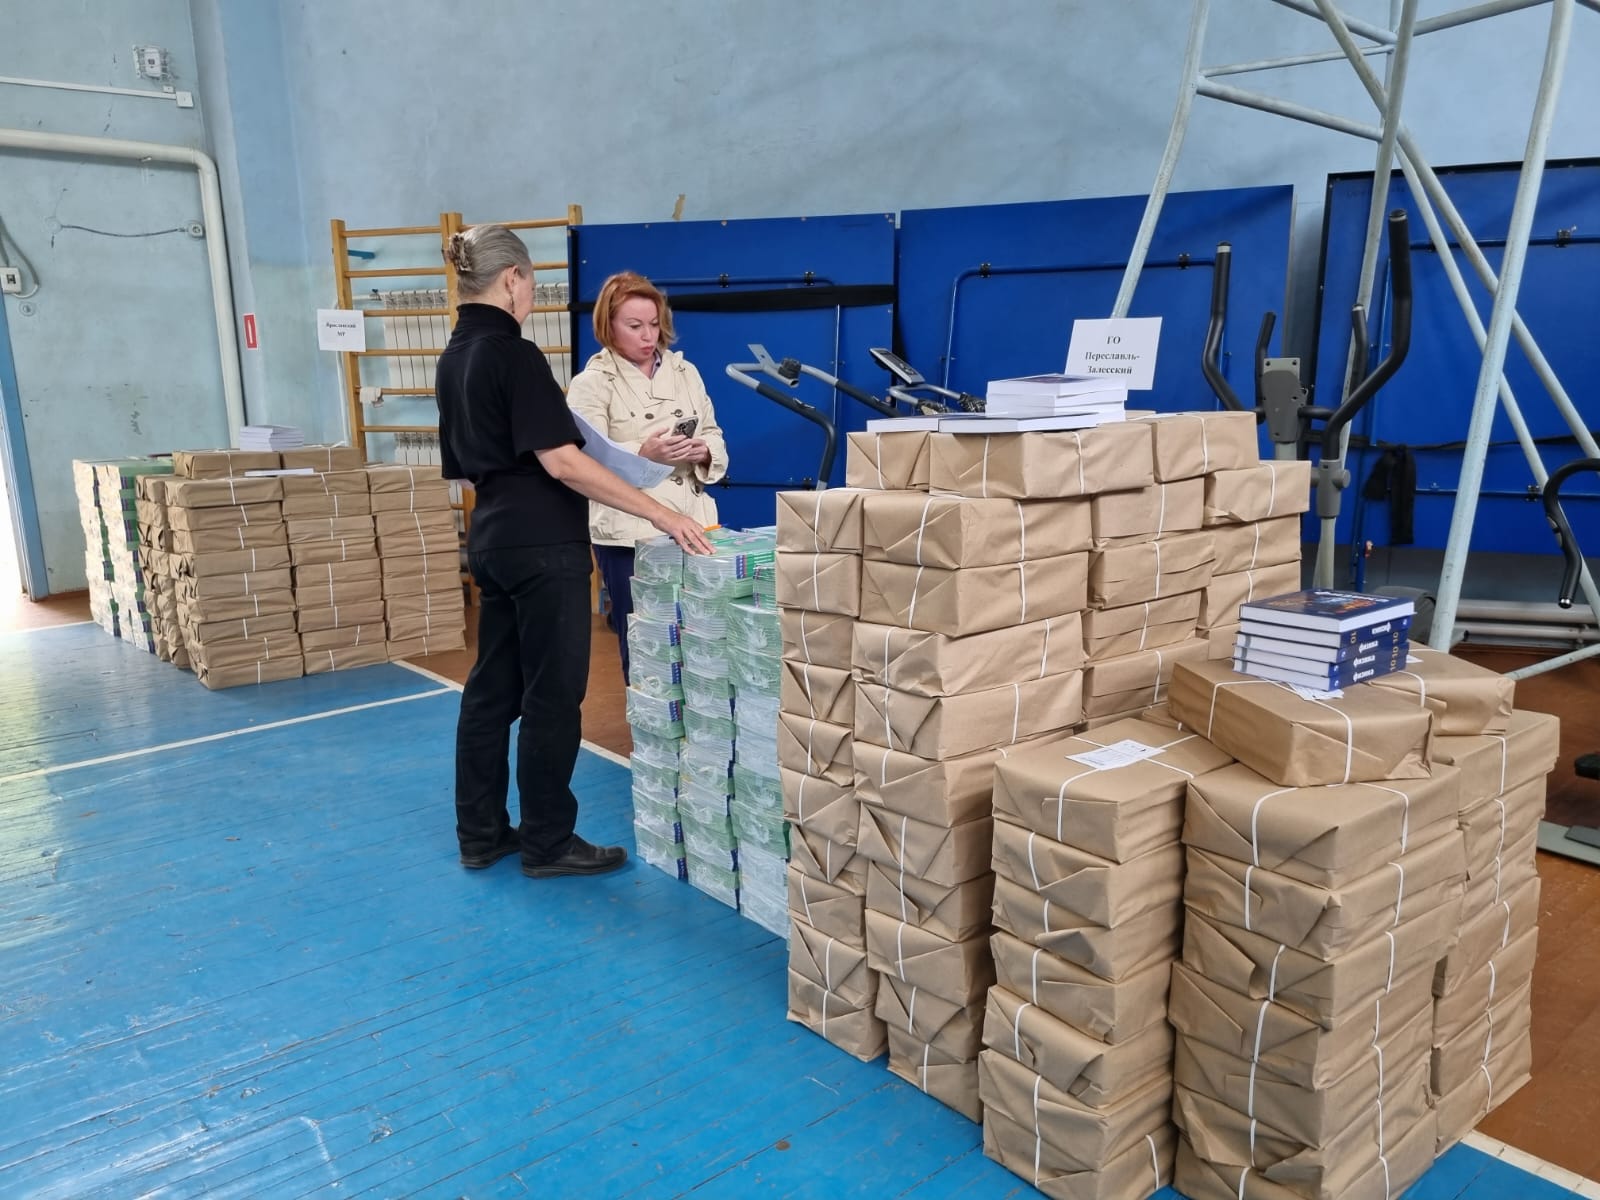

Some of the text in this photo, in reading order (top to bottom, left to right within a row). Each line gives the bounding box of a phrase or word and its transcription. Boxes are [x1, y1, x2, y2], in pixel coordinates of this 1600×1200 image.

[1106, 335, 1121, 345] ГО
[1085, 351, 1141, 361] Переславль-
[1087, 365, 1132, 375] Залесский
